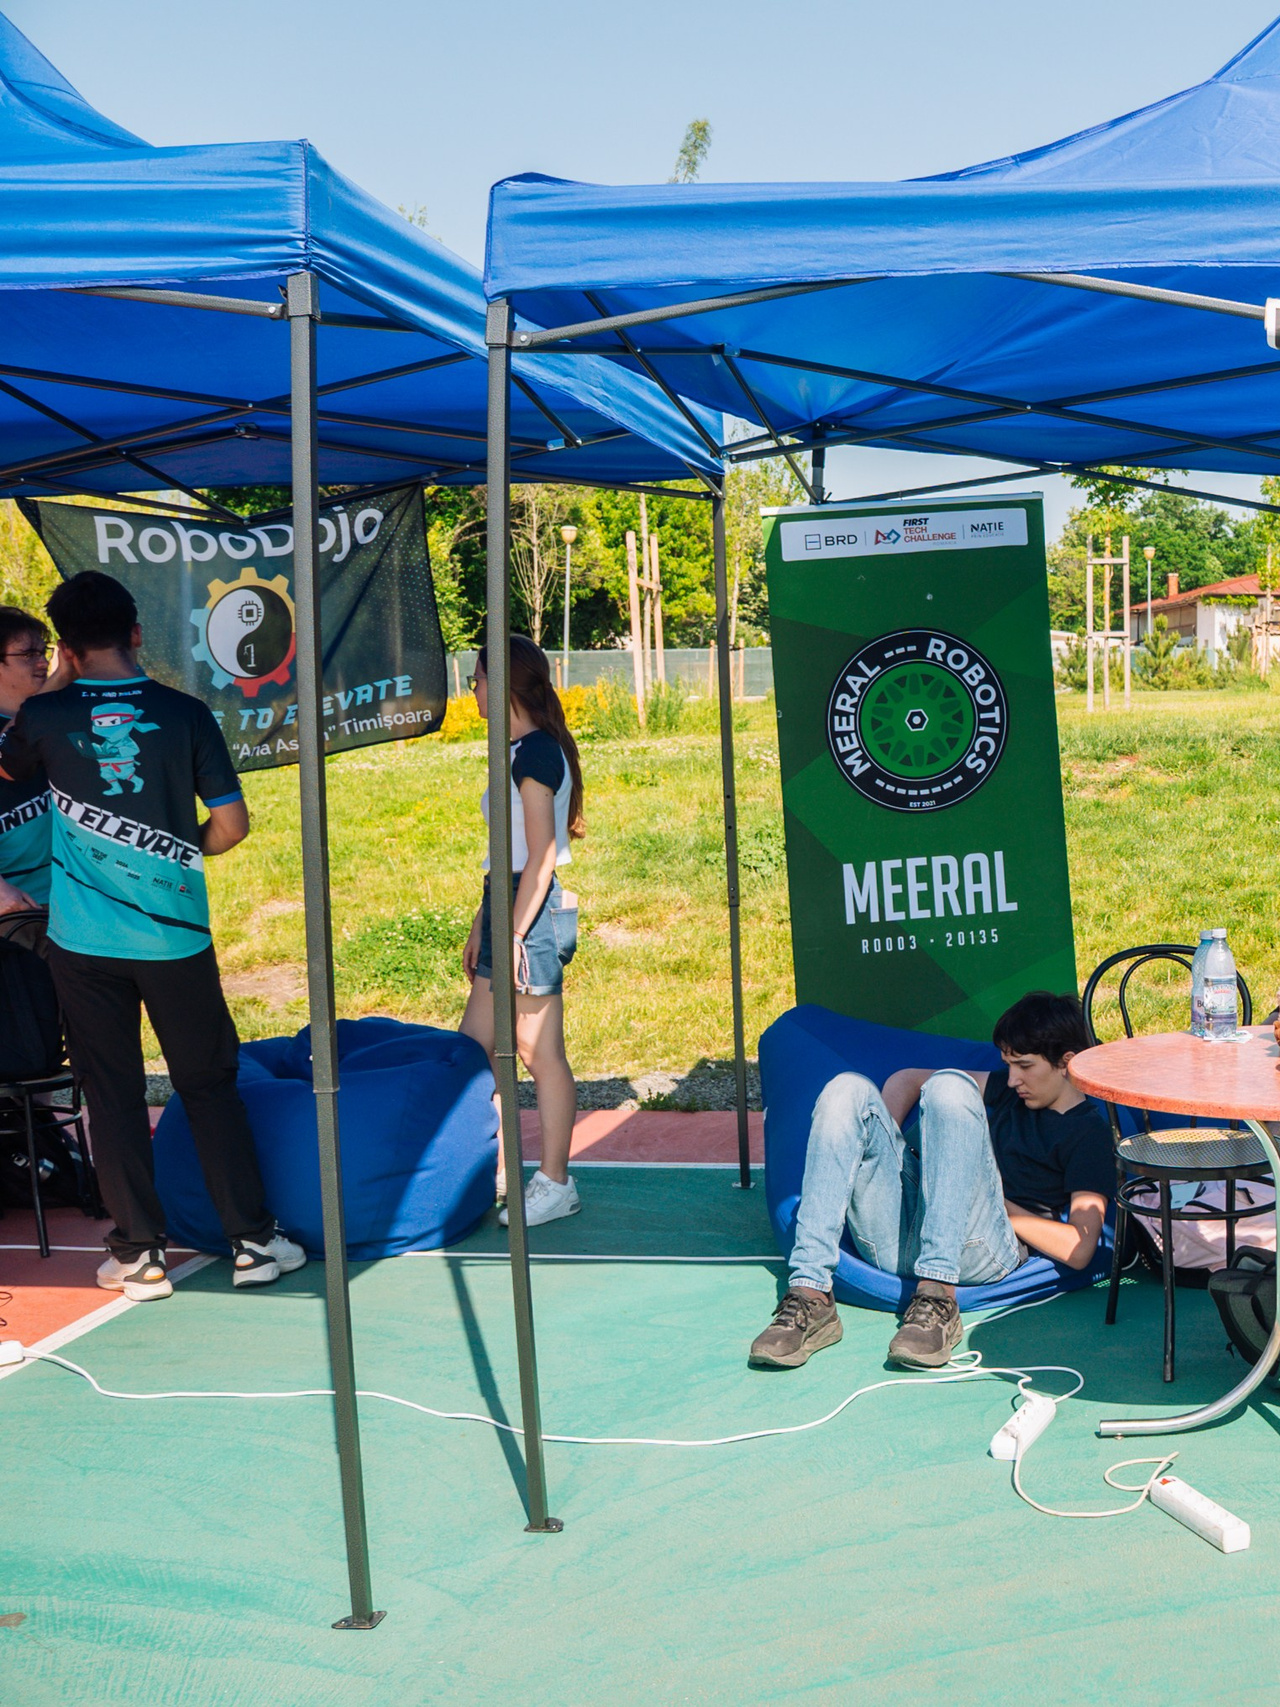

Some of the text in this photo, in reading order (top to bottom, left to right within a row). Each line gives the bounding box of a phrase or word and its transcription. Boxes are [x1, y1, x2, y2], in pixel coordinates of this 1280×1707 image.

[903, 517, 930, 527] FIRST
[903, 526, 928, 535] TECH
[824, 534, 858, 546] BRD
[903, 532, 957, 543] CHALLENGE
[238, 707, 276, 731] TO
[282, 674, 414, 727] EEVATE
[925, 637, 1001, 775] ROBOTICS
[339, 708, 433, 737] Timișoara
[833, 659, 882, 778] MEERAL
[77, 804, 200, 868] ELEVATE
[842, 850, 1018, 925] MEERAL
[945, 928, 999, 947] 20135
